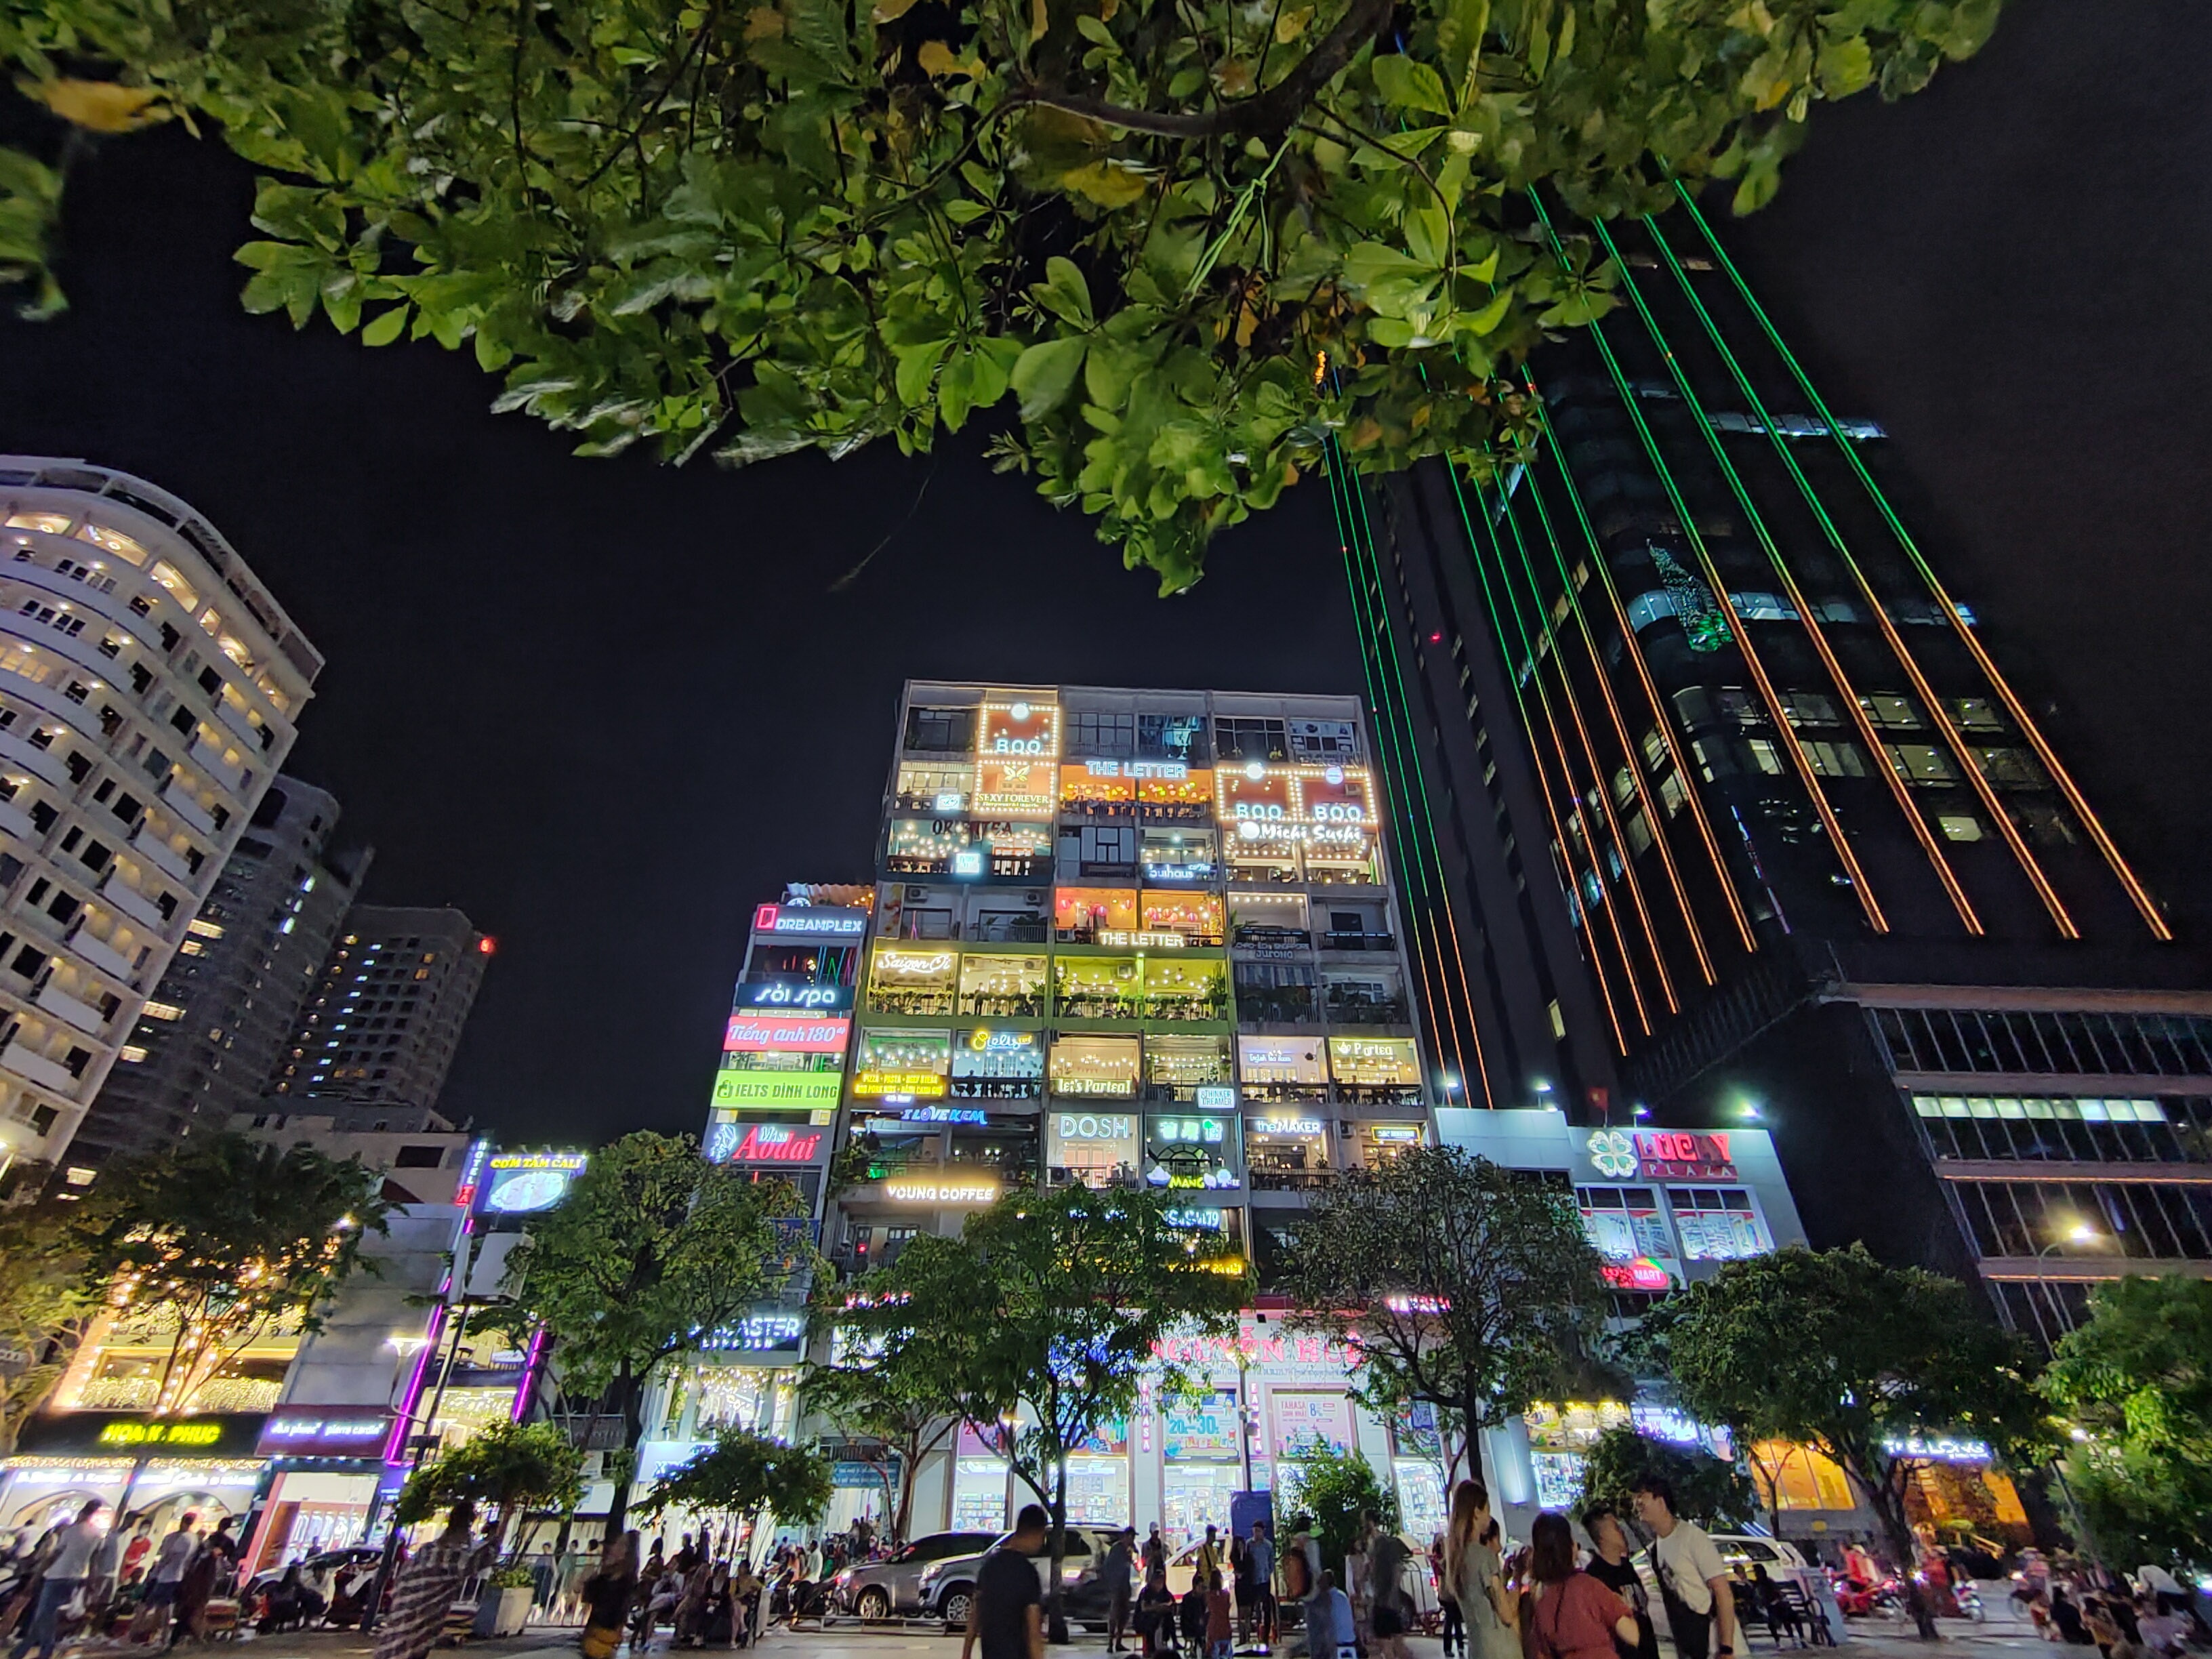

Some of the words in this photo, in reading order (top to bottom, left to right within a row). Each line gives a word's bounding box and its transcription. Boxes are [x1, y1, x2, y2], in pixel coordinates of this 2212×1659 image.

[1085, 761, 1118, 776] THE
[1124, 762, 1187, 778] LETTER
[979, 794, 1004, 802] SEXY
[1005, 794, 1049, 803] FOREVER
[1261, 823, 1307, 839] Michi
[1313, 825, 1361, 840] Sushi
[775, 918, 862, 932] DREAMPLEX
[1099, 932, 1128, 945] THE
[1131, 933, 1185, 947] LETTER
[878, 954, 930, 974] Saigon
[794, 989, 836, 1007] spa
[730, 1023, 770, 1044] Tiếng
[735, 1084, 769, 1097] IELTS
[772, 1082, 802, 1098] ĐÌNH
[806, 1086, 838, 1098] LONG
[914, 1106, 950, 1121] LOVE
[949, 1109, 988, 1125] KEM
[1060, 1115, 1129, 1139] DOSH
[1633, 1133, 1732, 1162] LUCKY
[466, 1141, 487, 1184] HOTEL
[552, 1158, 581, 1169] CALI
[1650, 1164, 1733, 1176] PLAZA
[887, 1185, 935, 1200] YOUNG
[940, 1187, 995, 1201] COFFEE
[1634, 1269, 1660, 1281] MART
